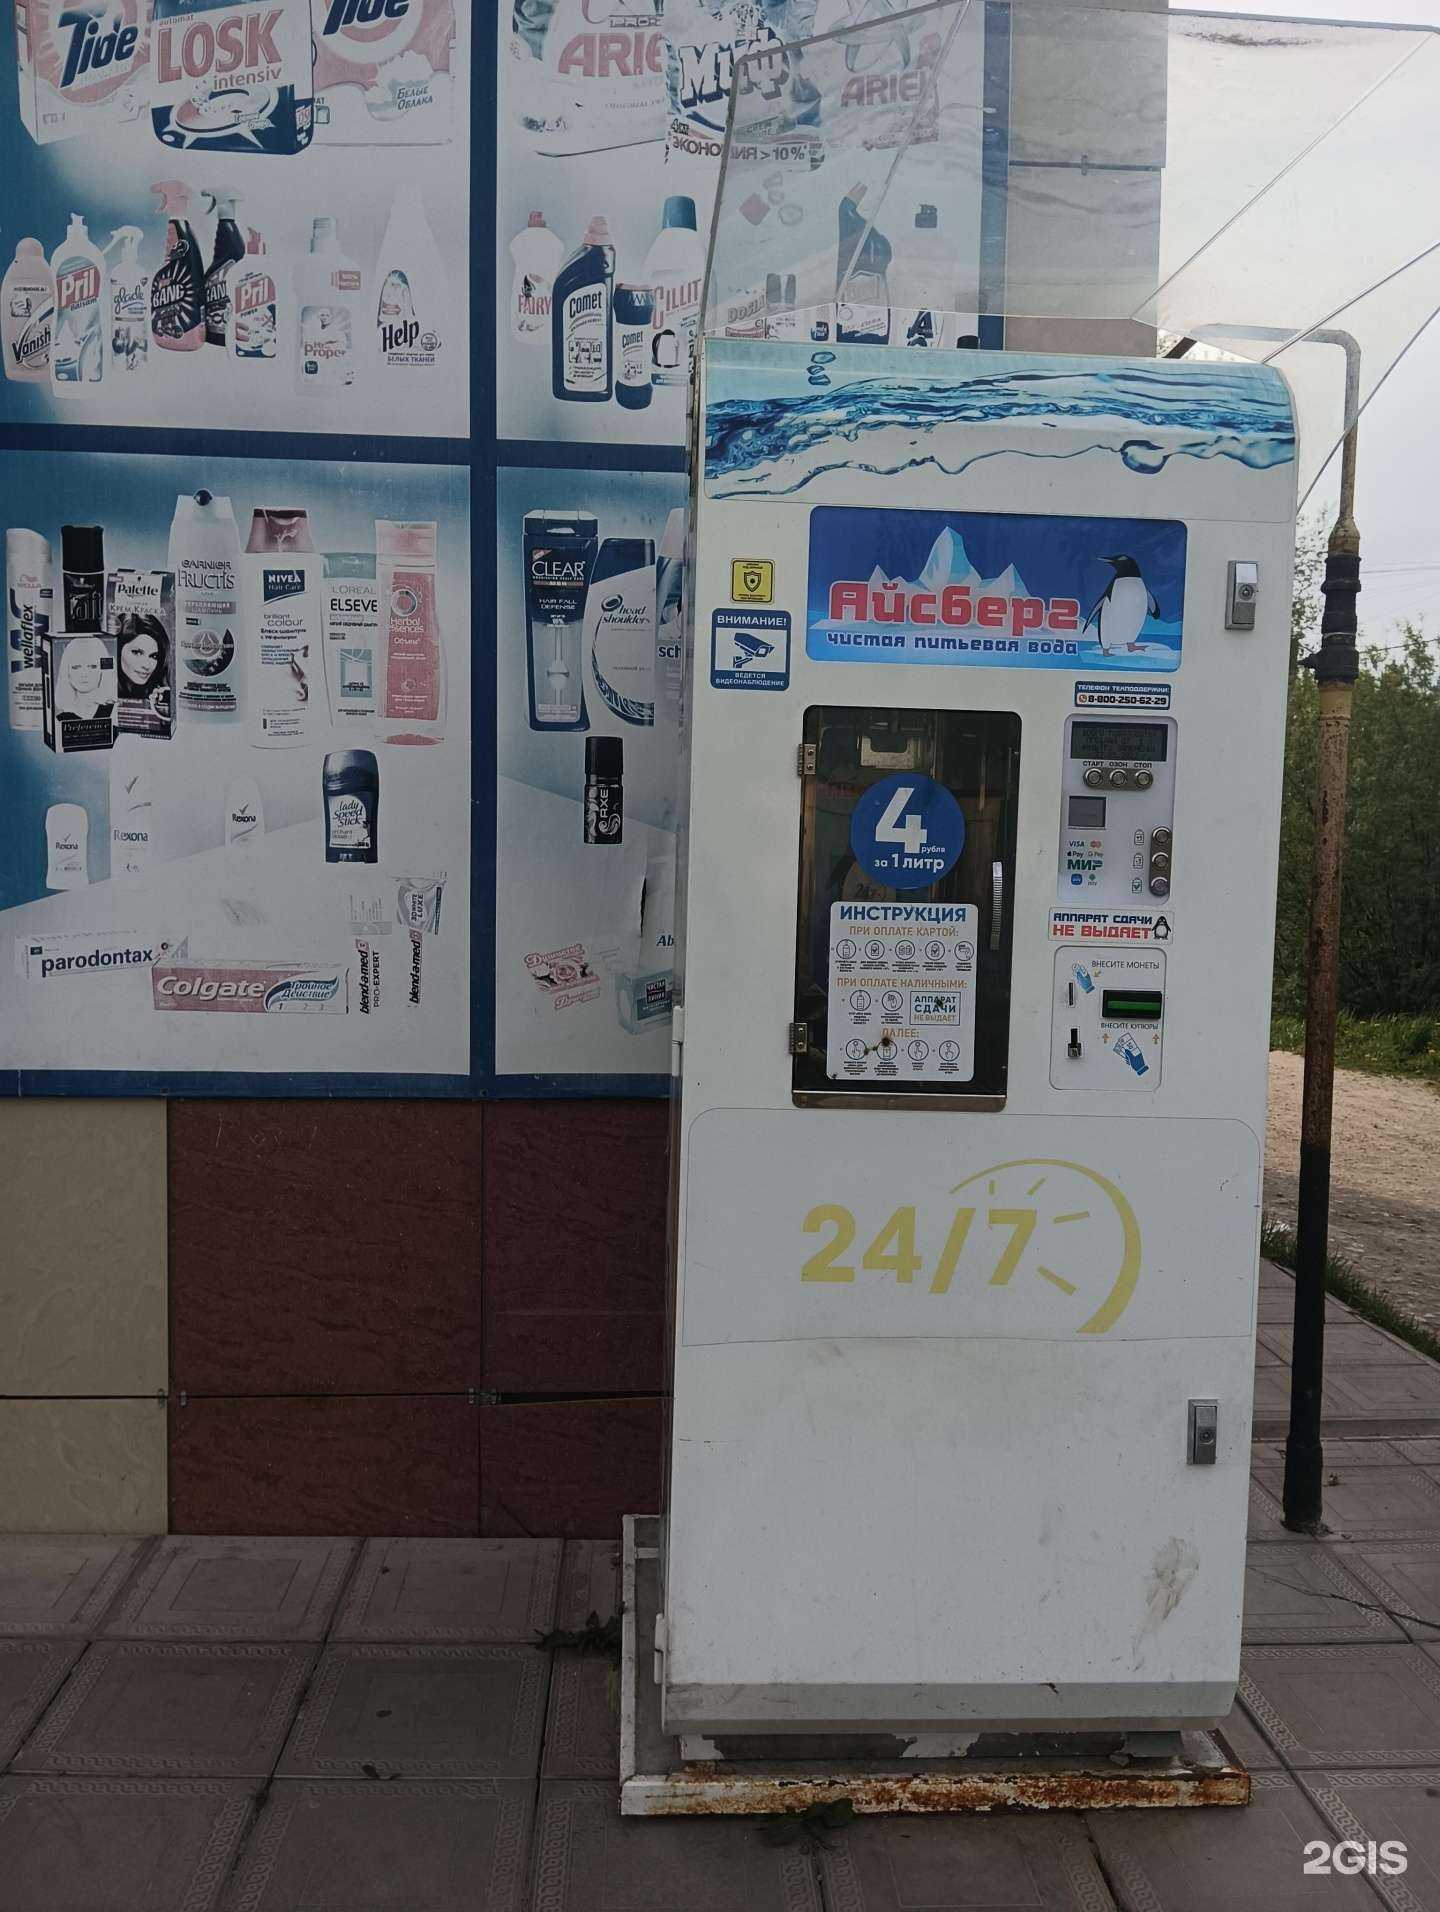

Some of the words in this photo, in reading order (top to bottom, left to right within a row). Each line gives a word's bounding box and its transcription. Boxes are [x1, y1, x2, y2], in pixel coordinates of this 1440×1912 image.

[58, 9, 139, 88] Tide
[157, 9, 285, 84] LOSK
[213, 66, 283, 91] intensiv
[61, 268, 96, 307] Pril
[240, 277, 269, 311] Pril
[113, 285, 145, 315] glade
[518, 295, 552, 315] FAIRY
[569, 291, 603, 319] Comet
[382, 319, 420, 353] Help
[621, 330, 644, 349] Comet
[11, 325, 51, 364] Vanish
[181, 560, 232, 570] GARNIER
[531, 561, 584, 577] CLEAR
[177, 569, 235, 590] FRUCTIS
[268, 573, 302, 583] NIVEA
[117, 582, 159, 598] Palette
[330, 598, 378, 612] ELSEVE
[619, 605, 647, 615] head
[830, 581, 1080, 637] Айсберг
[267, 618, 303, 627] colour
[602, 614, 650, 625] shoulders
[717, 615, 787, 627] ВНИМАНИЕ!
[20, 604, 34, 669] wellaflex
[827, 632, 906, 648] чистая
[914, 636, 1019, 653] питьевая
[1028, 641, 1078, 656] вода
[715, 678, 785, 687] ВИДЕОНАБЛЮДЕНИЕ
[339, 800, 360, 811] lady
[600, 789, 608, 818] AXE
[231, 813, 256, 822] Rexona
[875, 787, 928, 854] 4
[113, 830, 149, 841] Rexona
[921, 845, 946, 854] рубля
[874, 858, 888, 868] за
[891, 854, 899, 868] 1
[902, 857, 945, 873] литр
[1067, 859, 1104, 870] МИР
[840, 905, 967, 924] ИНСТРУКЦИЯ
[1053, 913, 1109, 923] АППАРАТ
[1113, 914, 1153, 925] СДАЧИ
[850, 926, 871, 936] ПРИ
[873, 926, 913, 937] ОПЛАТЕ
[916, 925, 959, 937] КАРТОЙ:
[1052, 925, 1075, 937] НЕ
[1081, 925, 1152, 939] ВЫДАЕТ
[42, 949, 153, 978] parodontax
[1091, 960, 1125, 968] ВНЕСИТЕ
[1126, 961, 1160, 969] МОНЕТЫ
[157, 975, 265, 1001] Colgate
[836, 977, 858, 987] ПРИ
[860, 978, 898, 988] ОПЛАТЕ
[900, 979, 968, 989] НАЛИЧНЫМИ:
[914, 995, 957, 1003] АППАРАТ
[914, 1004, 956, 1014] СДАЧИ
[1100, 1022, 1129, 1030] ВНЕСИТЕ
[800, 1203, 1037, 1294] 24/7
